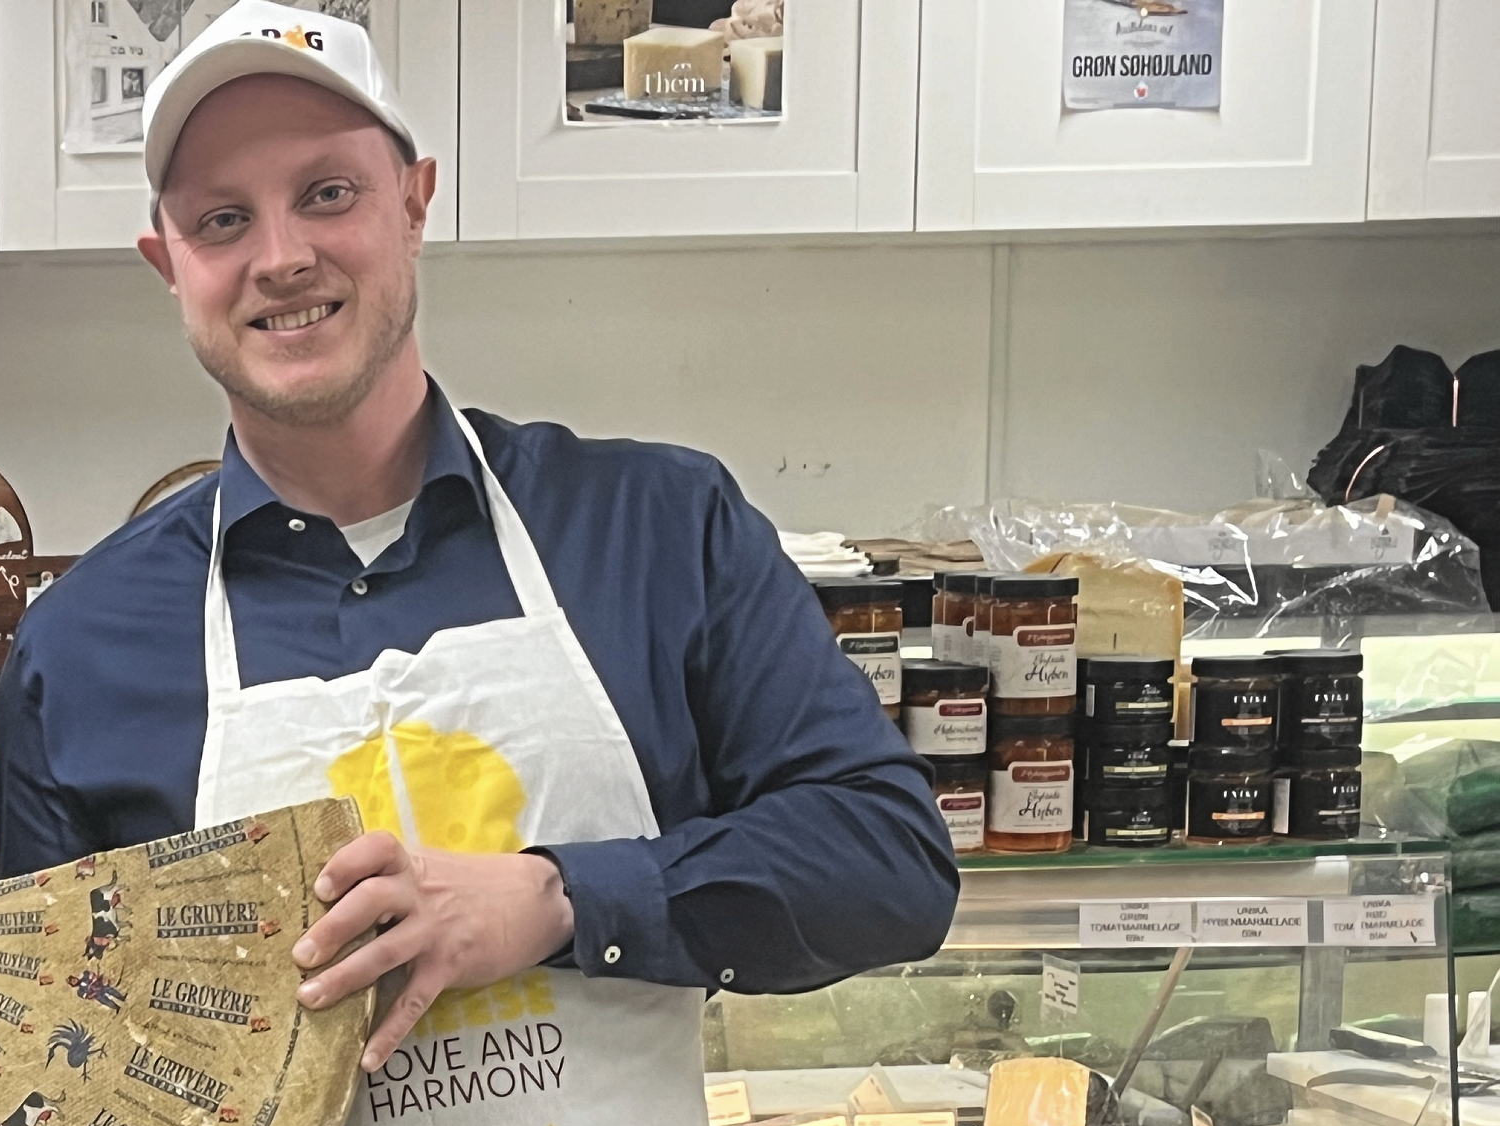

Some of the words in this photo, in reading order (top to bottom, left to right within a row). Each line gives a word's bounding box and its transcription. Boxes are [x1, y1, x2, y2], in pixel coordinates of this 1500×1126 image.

[1072, 55, 1116, 77] GRØN
[1119, 54, 1212, 76] SØHØJLAND
[157, 905, 177, 927] LE
[151, 977, 172, 999] LE
[481, 1023, 563, 1066] AND
[129, 1045, 154, 1071] LE
[369, 1056, 565, 1122] HARMONY
